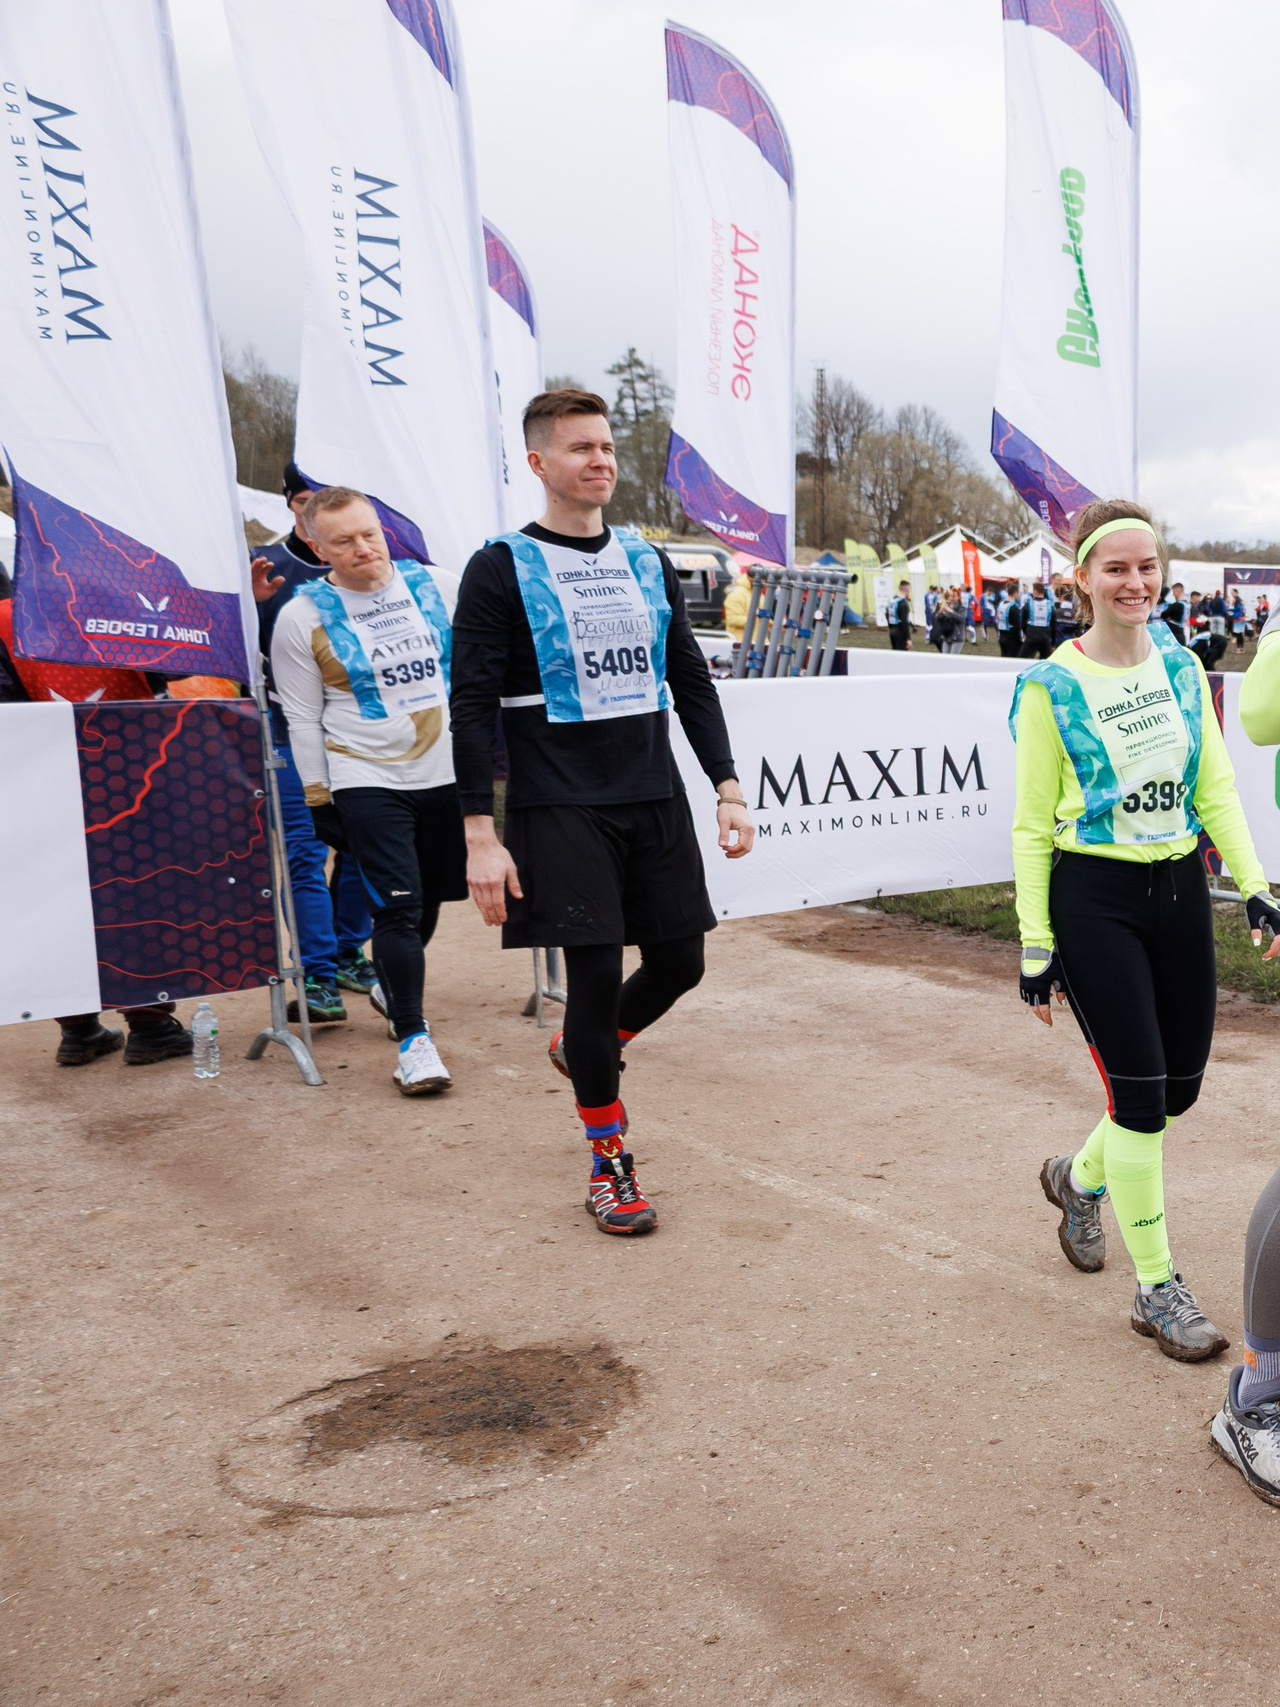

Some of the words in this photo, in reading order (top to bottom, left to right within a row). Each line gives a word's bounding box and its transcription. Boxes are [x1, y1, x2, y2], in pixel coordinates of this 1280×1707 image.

[556, 570, 593, 581] ГОНКА
[594, 568, 630, 577] ГЕРОЕВ
[573, 584, 628, 599] Sminex
[367, 614, 411, 632] Sminex
[382, 657, 436, 687] 5399
[583, 646, 649, 679] 5409
[1097, 700, 1135, 719] ГОНКА
[1136, 689, 1171, 706] ГЕРОЕВ
[1117, 712, 1171, 738] Sminex
[1125, 730, 1177, 752] ПЕРФЕКЦИОНИСТЫ
[1128, 751, 1142, 759] FINE
[753, 742, 990, 811] MAXIM
[1122, 780, 1187, 814] 5398
[758, 803, 988, 838] MAXIMONLINE.RU
[1237, 1427, 1259, 1464] HOKA
